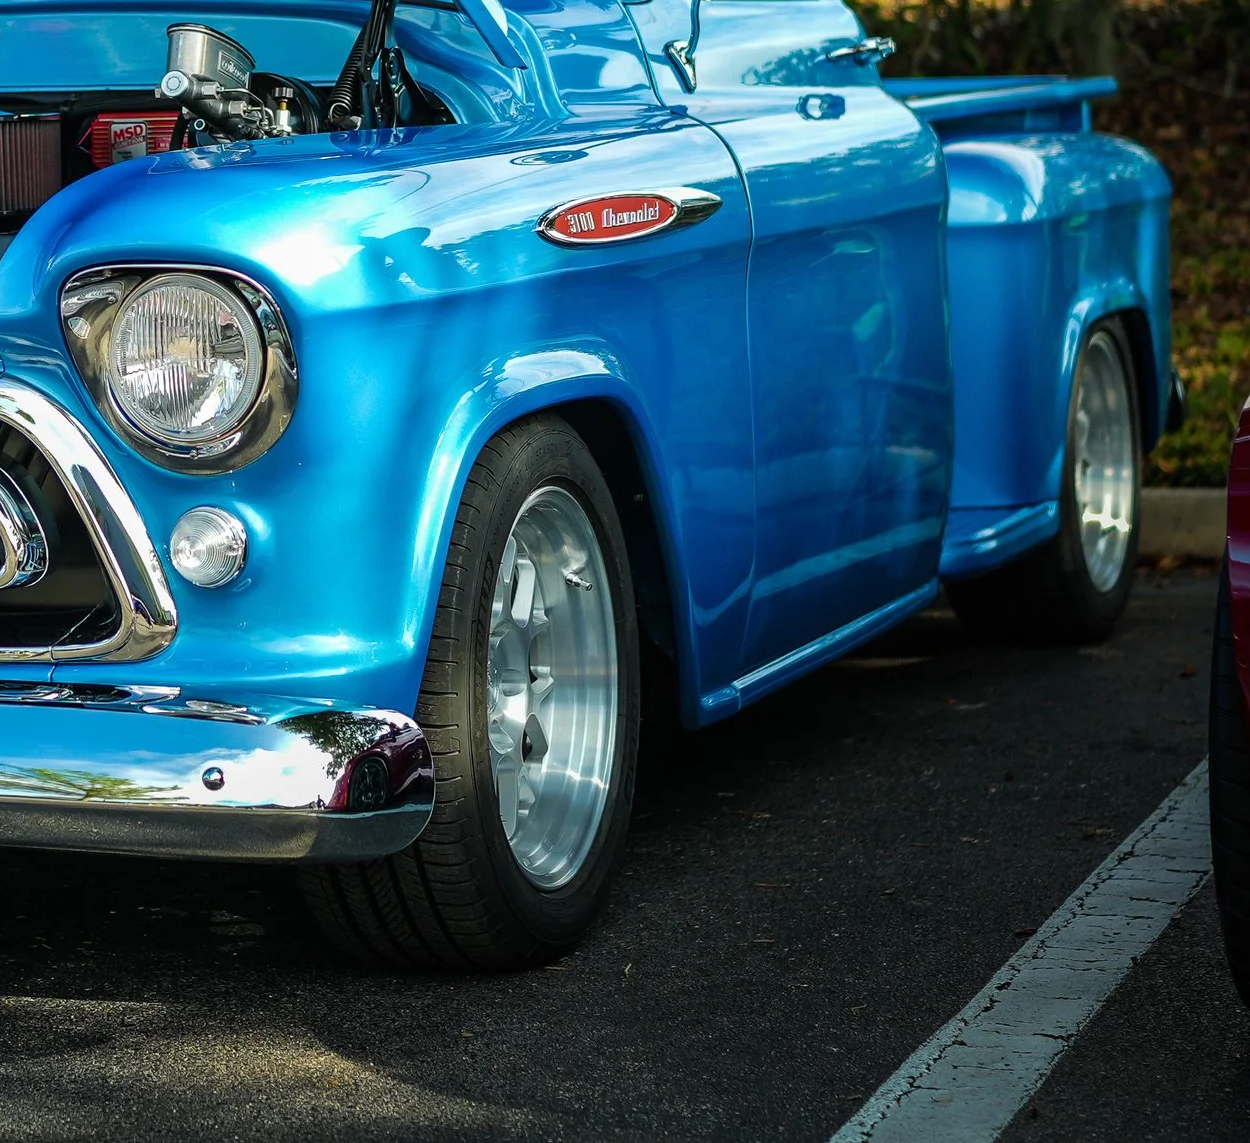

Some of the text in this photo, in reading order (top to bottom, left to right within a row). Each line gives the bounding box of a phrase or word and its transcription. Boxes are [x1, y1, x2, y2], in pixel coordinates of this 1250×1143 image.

[113, 124, 144, 143] MSD
[565, 200, 660, 234] 3100 Chevrolet
